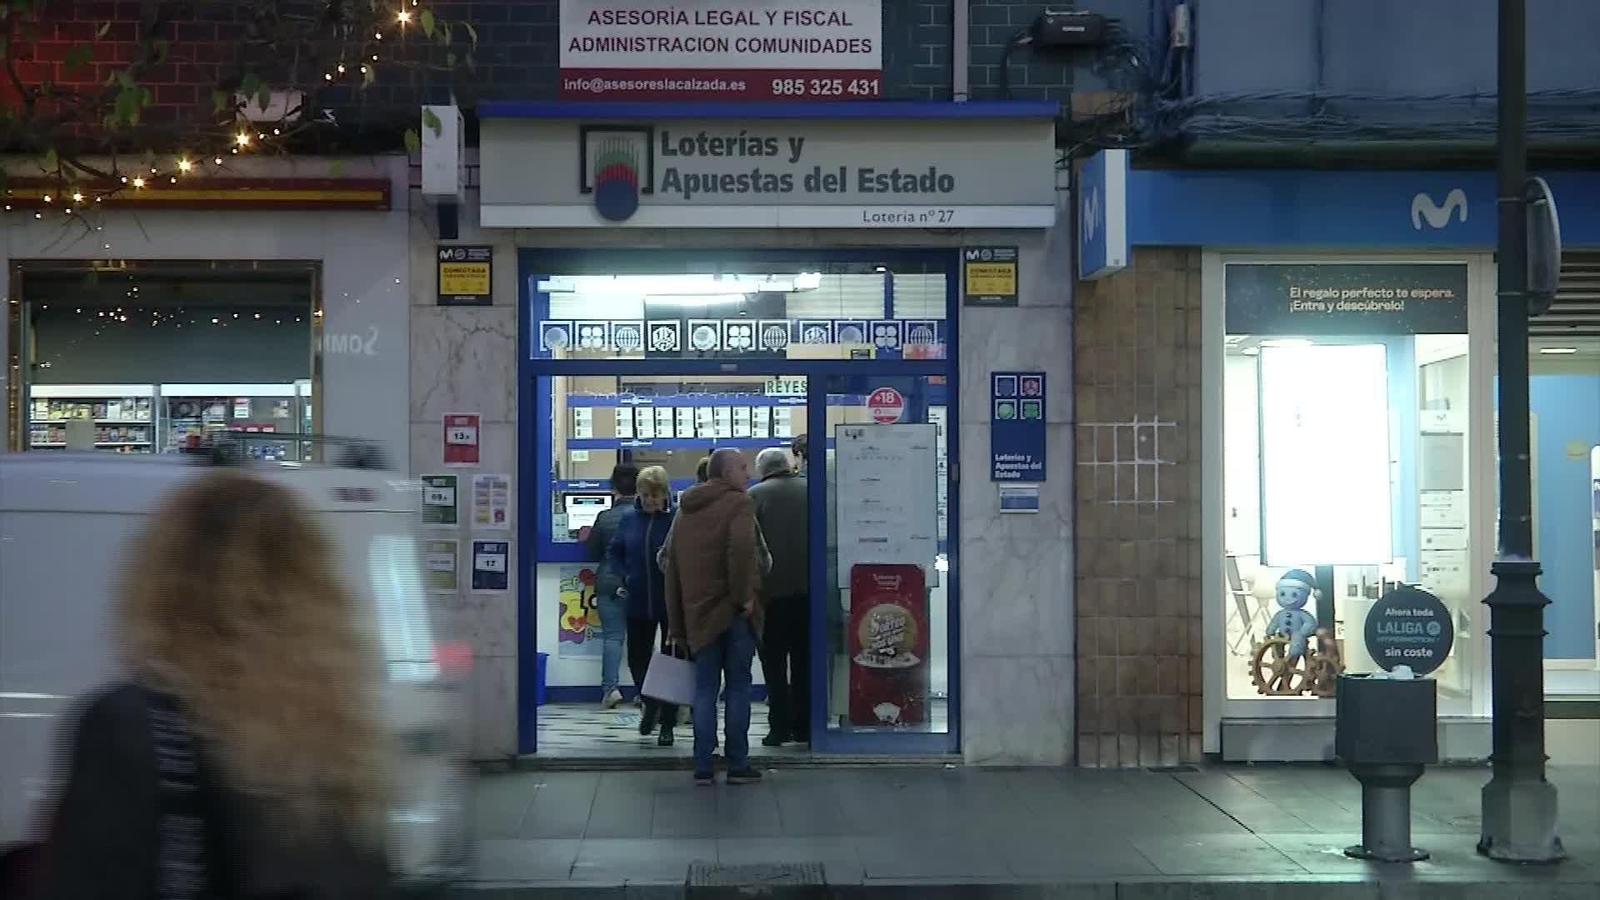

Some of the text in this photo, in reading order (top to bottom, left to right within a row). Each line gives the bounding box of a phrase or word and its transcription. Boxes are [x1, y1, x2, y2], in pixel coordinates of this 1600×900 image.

[588, 6, 853, 27] ASESORÍA LEGAL Y FISCAL
[568, 37, 873, 55] ADMINISTRACION COMUNIDADES
[563, 78, 880, 96] info@asesoreslacalzada.es 985 325 431
[661, 129, 805, 164] Loterías y
[661, 165, 956, 199] Apuestas del Estado
[938, 210, 955, 223] 27
[1289, 287, 1455, 300] El regalo perfecto te espera.
[1327, 302, 1335, 313] y
[1336, 300, 1405, 311] descúbrelo!
[766, 380, 808, 394] REYES
[874, 391, 895, 404] +18
[1030, 461, 1043, 470] del
[994, 470, 1021, 479] Estado
[1385, 607, 1434, 617] Ahora toda
[1377, 621, 1423, 634] LALIGA
[1384, 646, 1433, 657] sin coste
